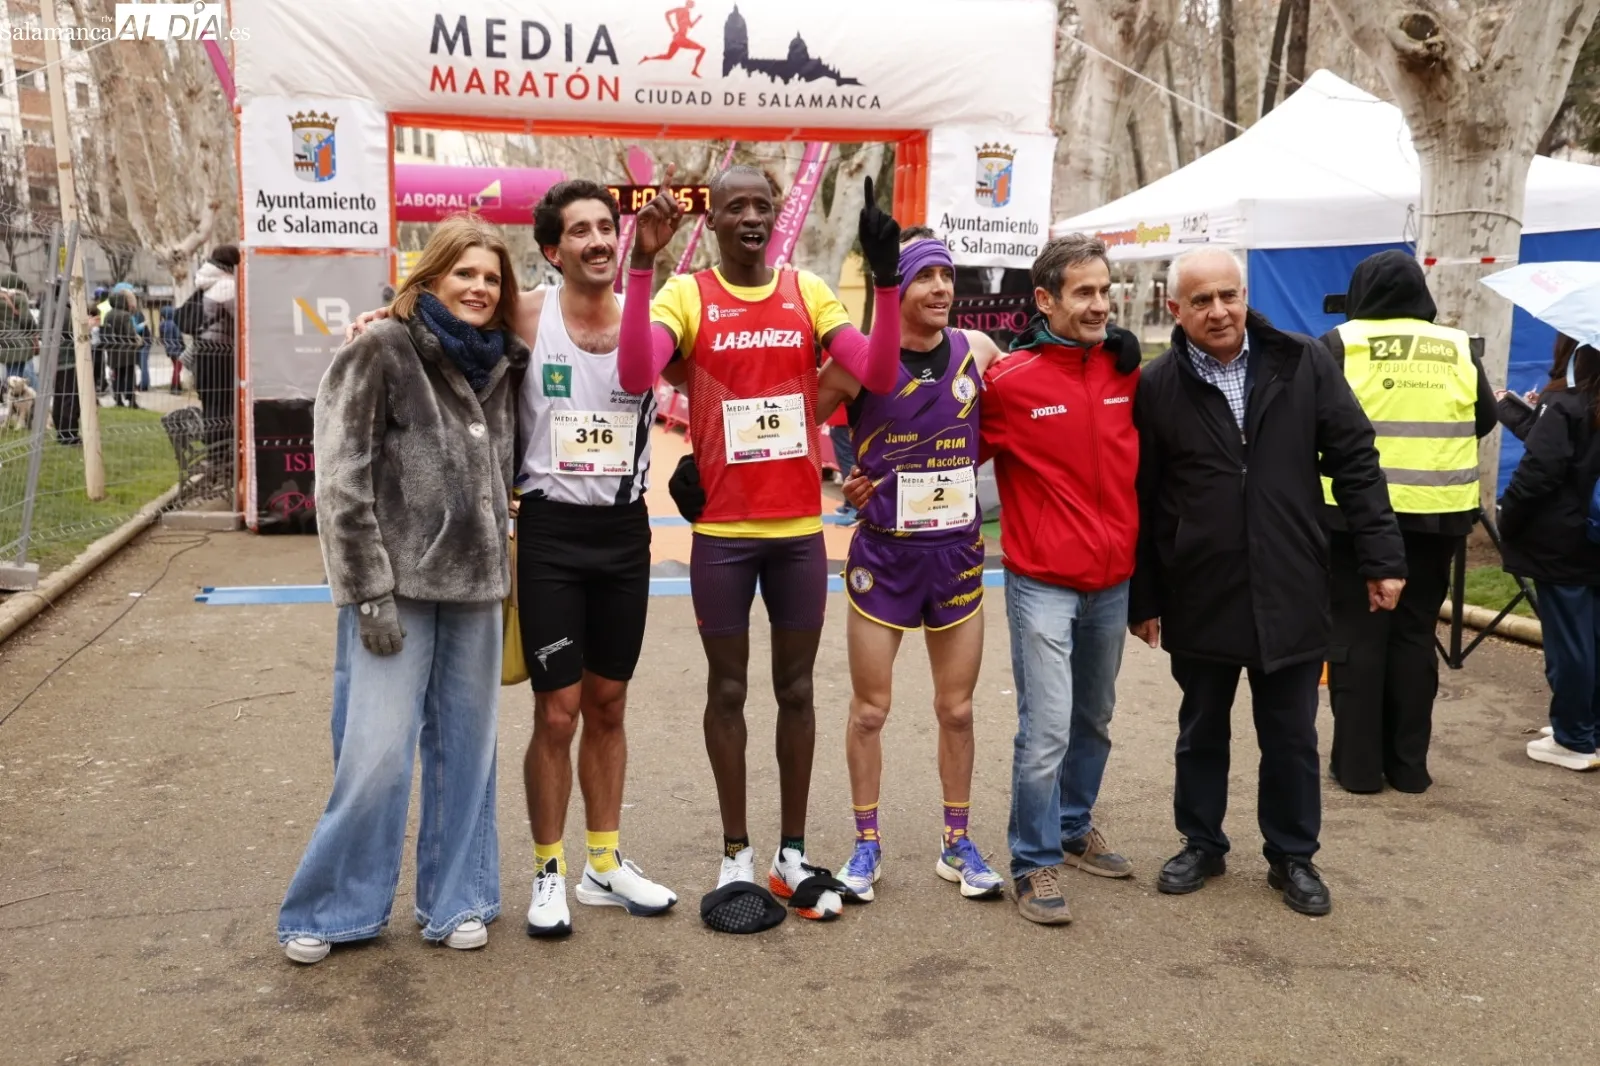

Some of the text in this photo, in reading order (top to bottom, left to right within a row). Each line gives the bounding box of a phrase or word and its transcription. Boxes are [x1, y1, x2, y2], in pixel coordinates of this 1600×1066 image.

[429, 14, 620, 65] MEDIA
[429, 65, 620, 103] MARATÓN
[634, 88, 882, 110] CIUDAD DE SALAMANCA
[256, 189, 376, 216] Ayuntamiento
[395, 192, 467, 208] LABORAL
[257, 215, 378, 235] de Salamanca
[940, 213, 1039, 236] Ayuntamiento
[961, 236, 1039, 257] Salamanca
[957, 312, 1028, 333] ISIDRO
[1373, 339, 1455, 357] 24 siete
[726, 405, 750, 413] MEDIA
[756, 414, 780, 430] 16
[576, 428, 613, 444] 316
[885, 431, 966, 451] Jamón PRIM
[927, 455, 970, 469] Macotera
[933, 487, 945, 502] 2
